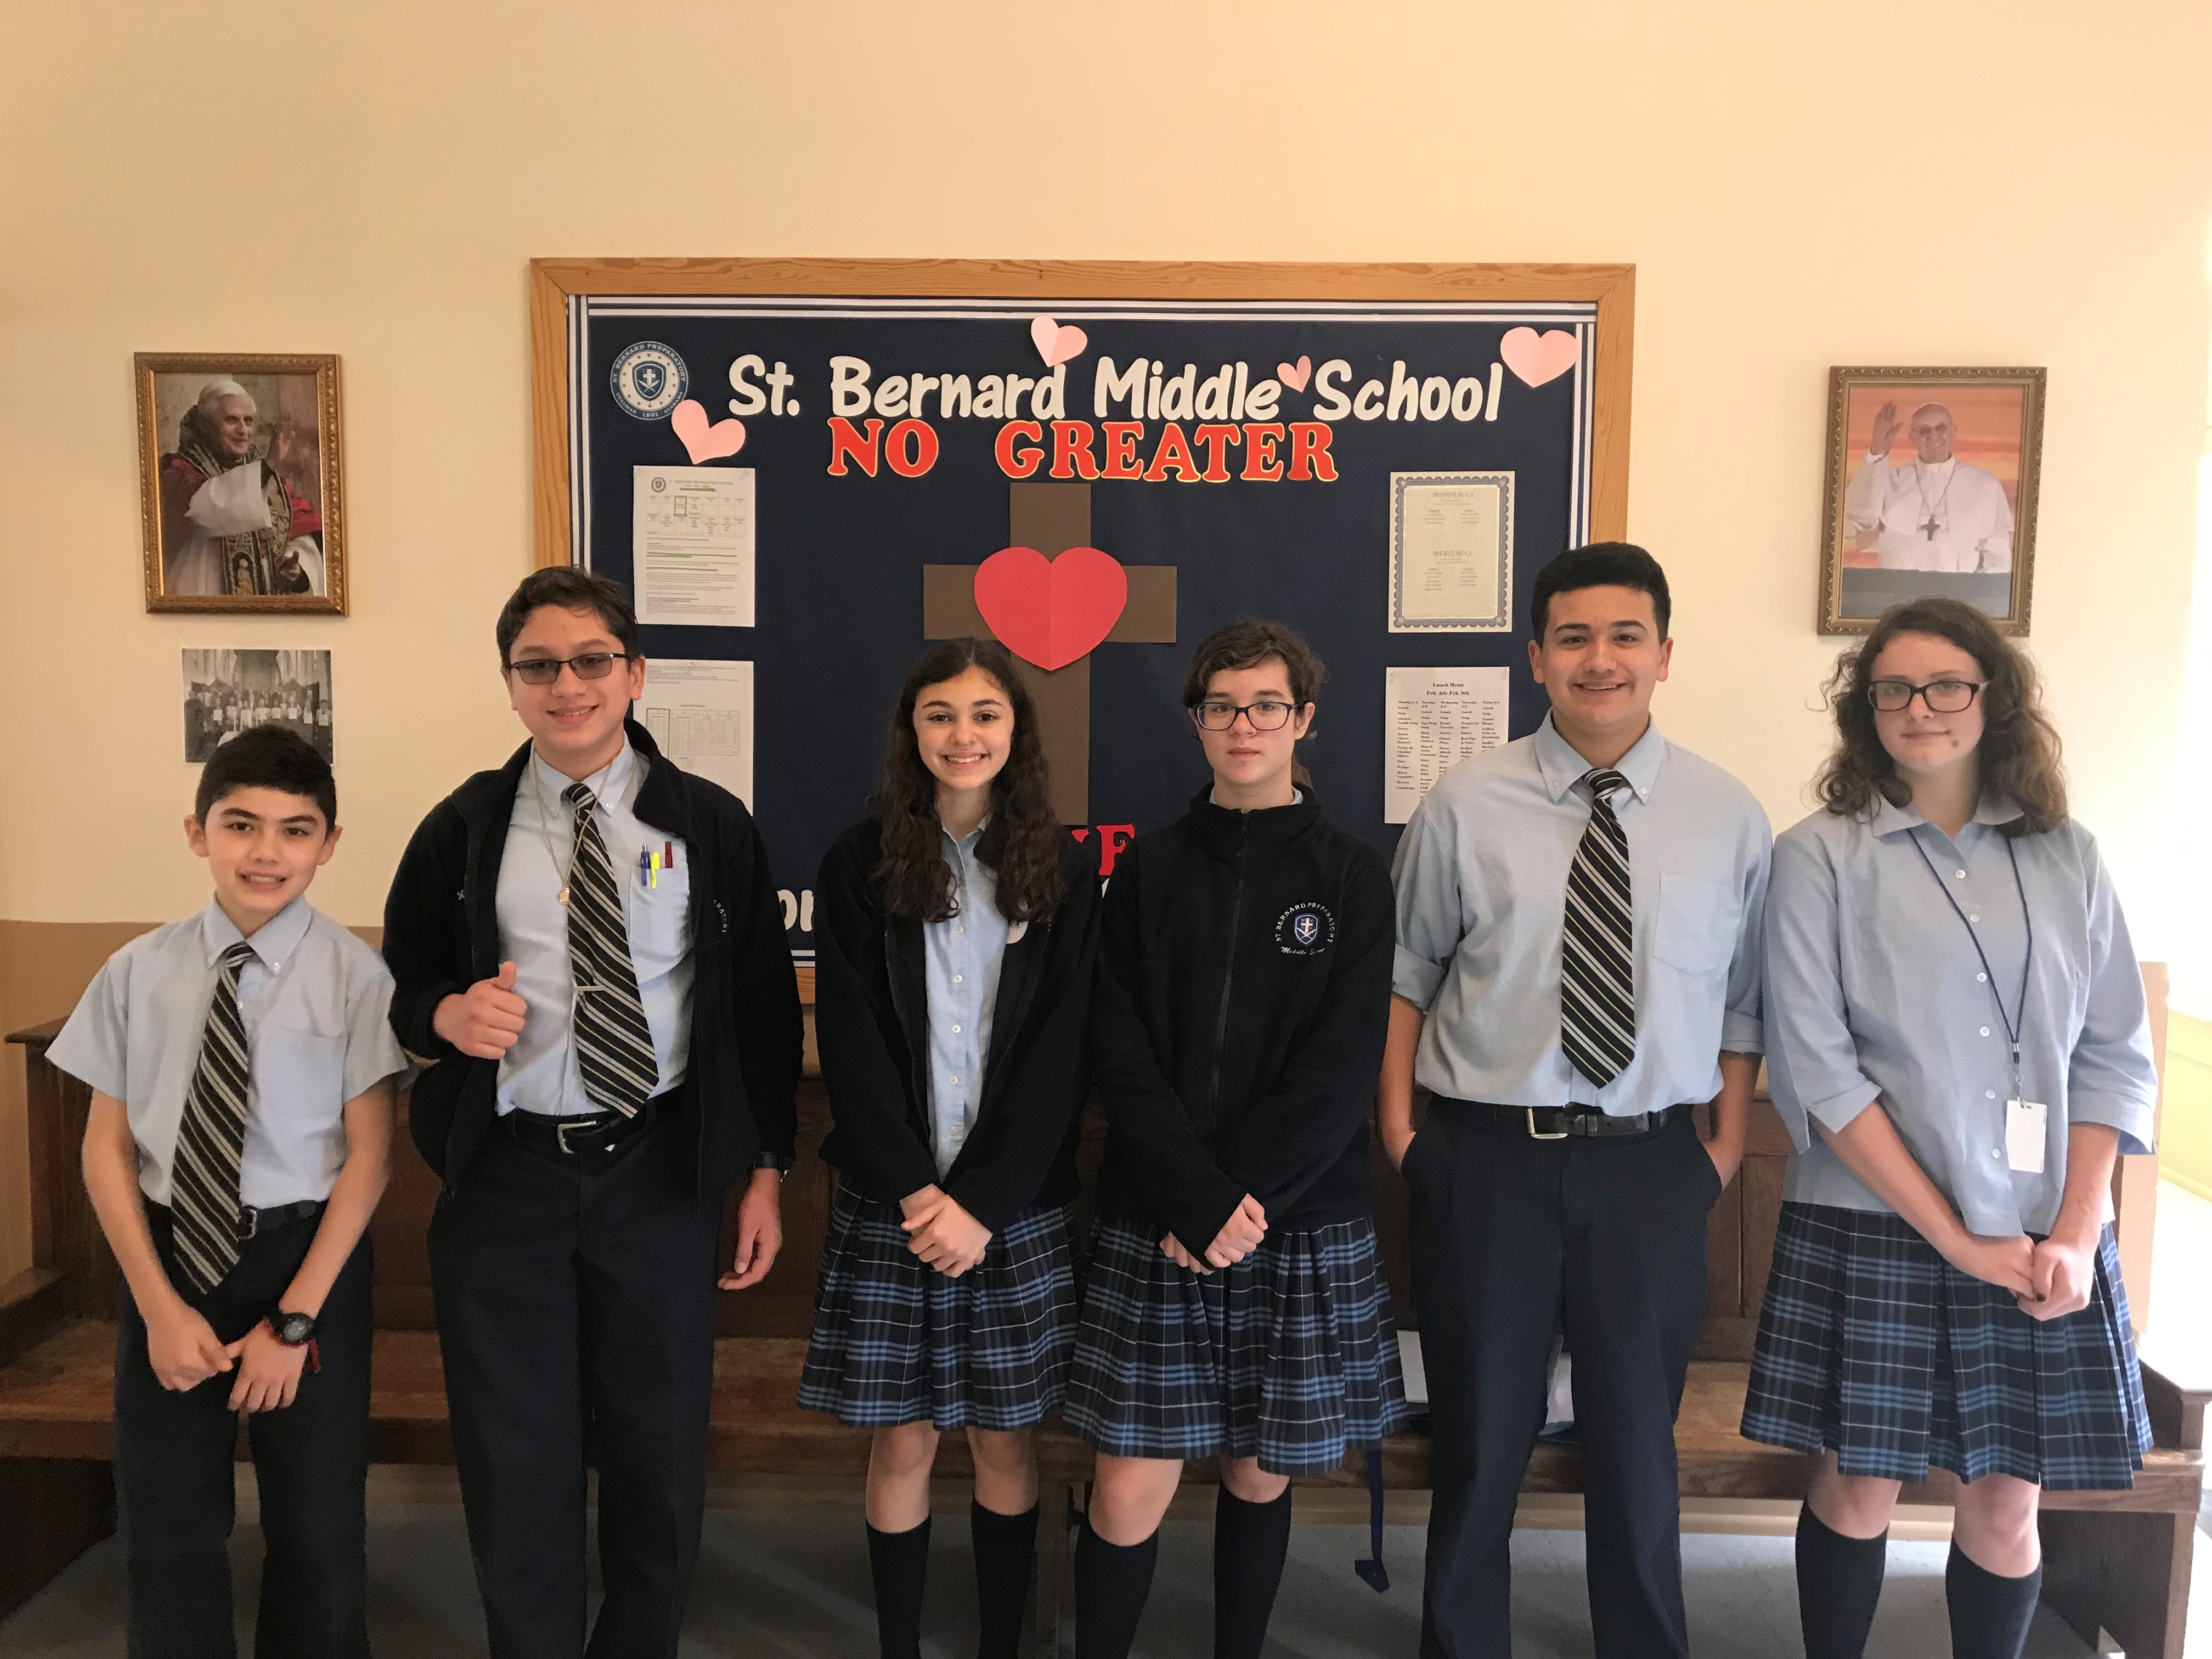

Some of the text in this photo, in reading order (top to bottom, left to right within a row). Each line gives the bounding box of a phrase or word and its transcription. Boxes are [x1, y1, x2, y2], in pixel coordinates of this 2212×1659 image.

[615, 343, 645, 369] BERNARD
[646, 343, 686, 382] PREPARATORY
[616, 392, 637, 414] CULLMAN
[663, 391, 683, 414] ALABAMA
[729, 354, 1504, 422] St. Bernard Middle School
[827, 417, 1339, 483] NO GREATER
[1275, 902, 1335, 944] ST BERNARD PREPARATORY
